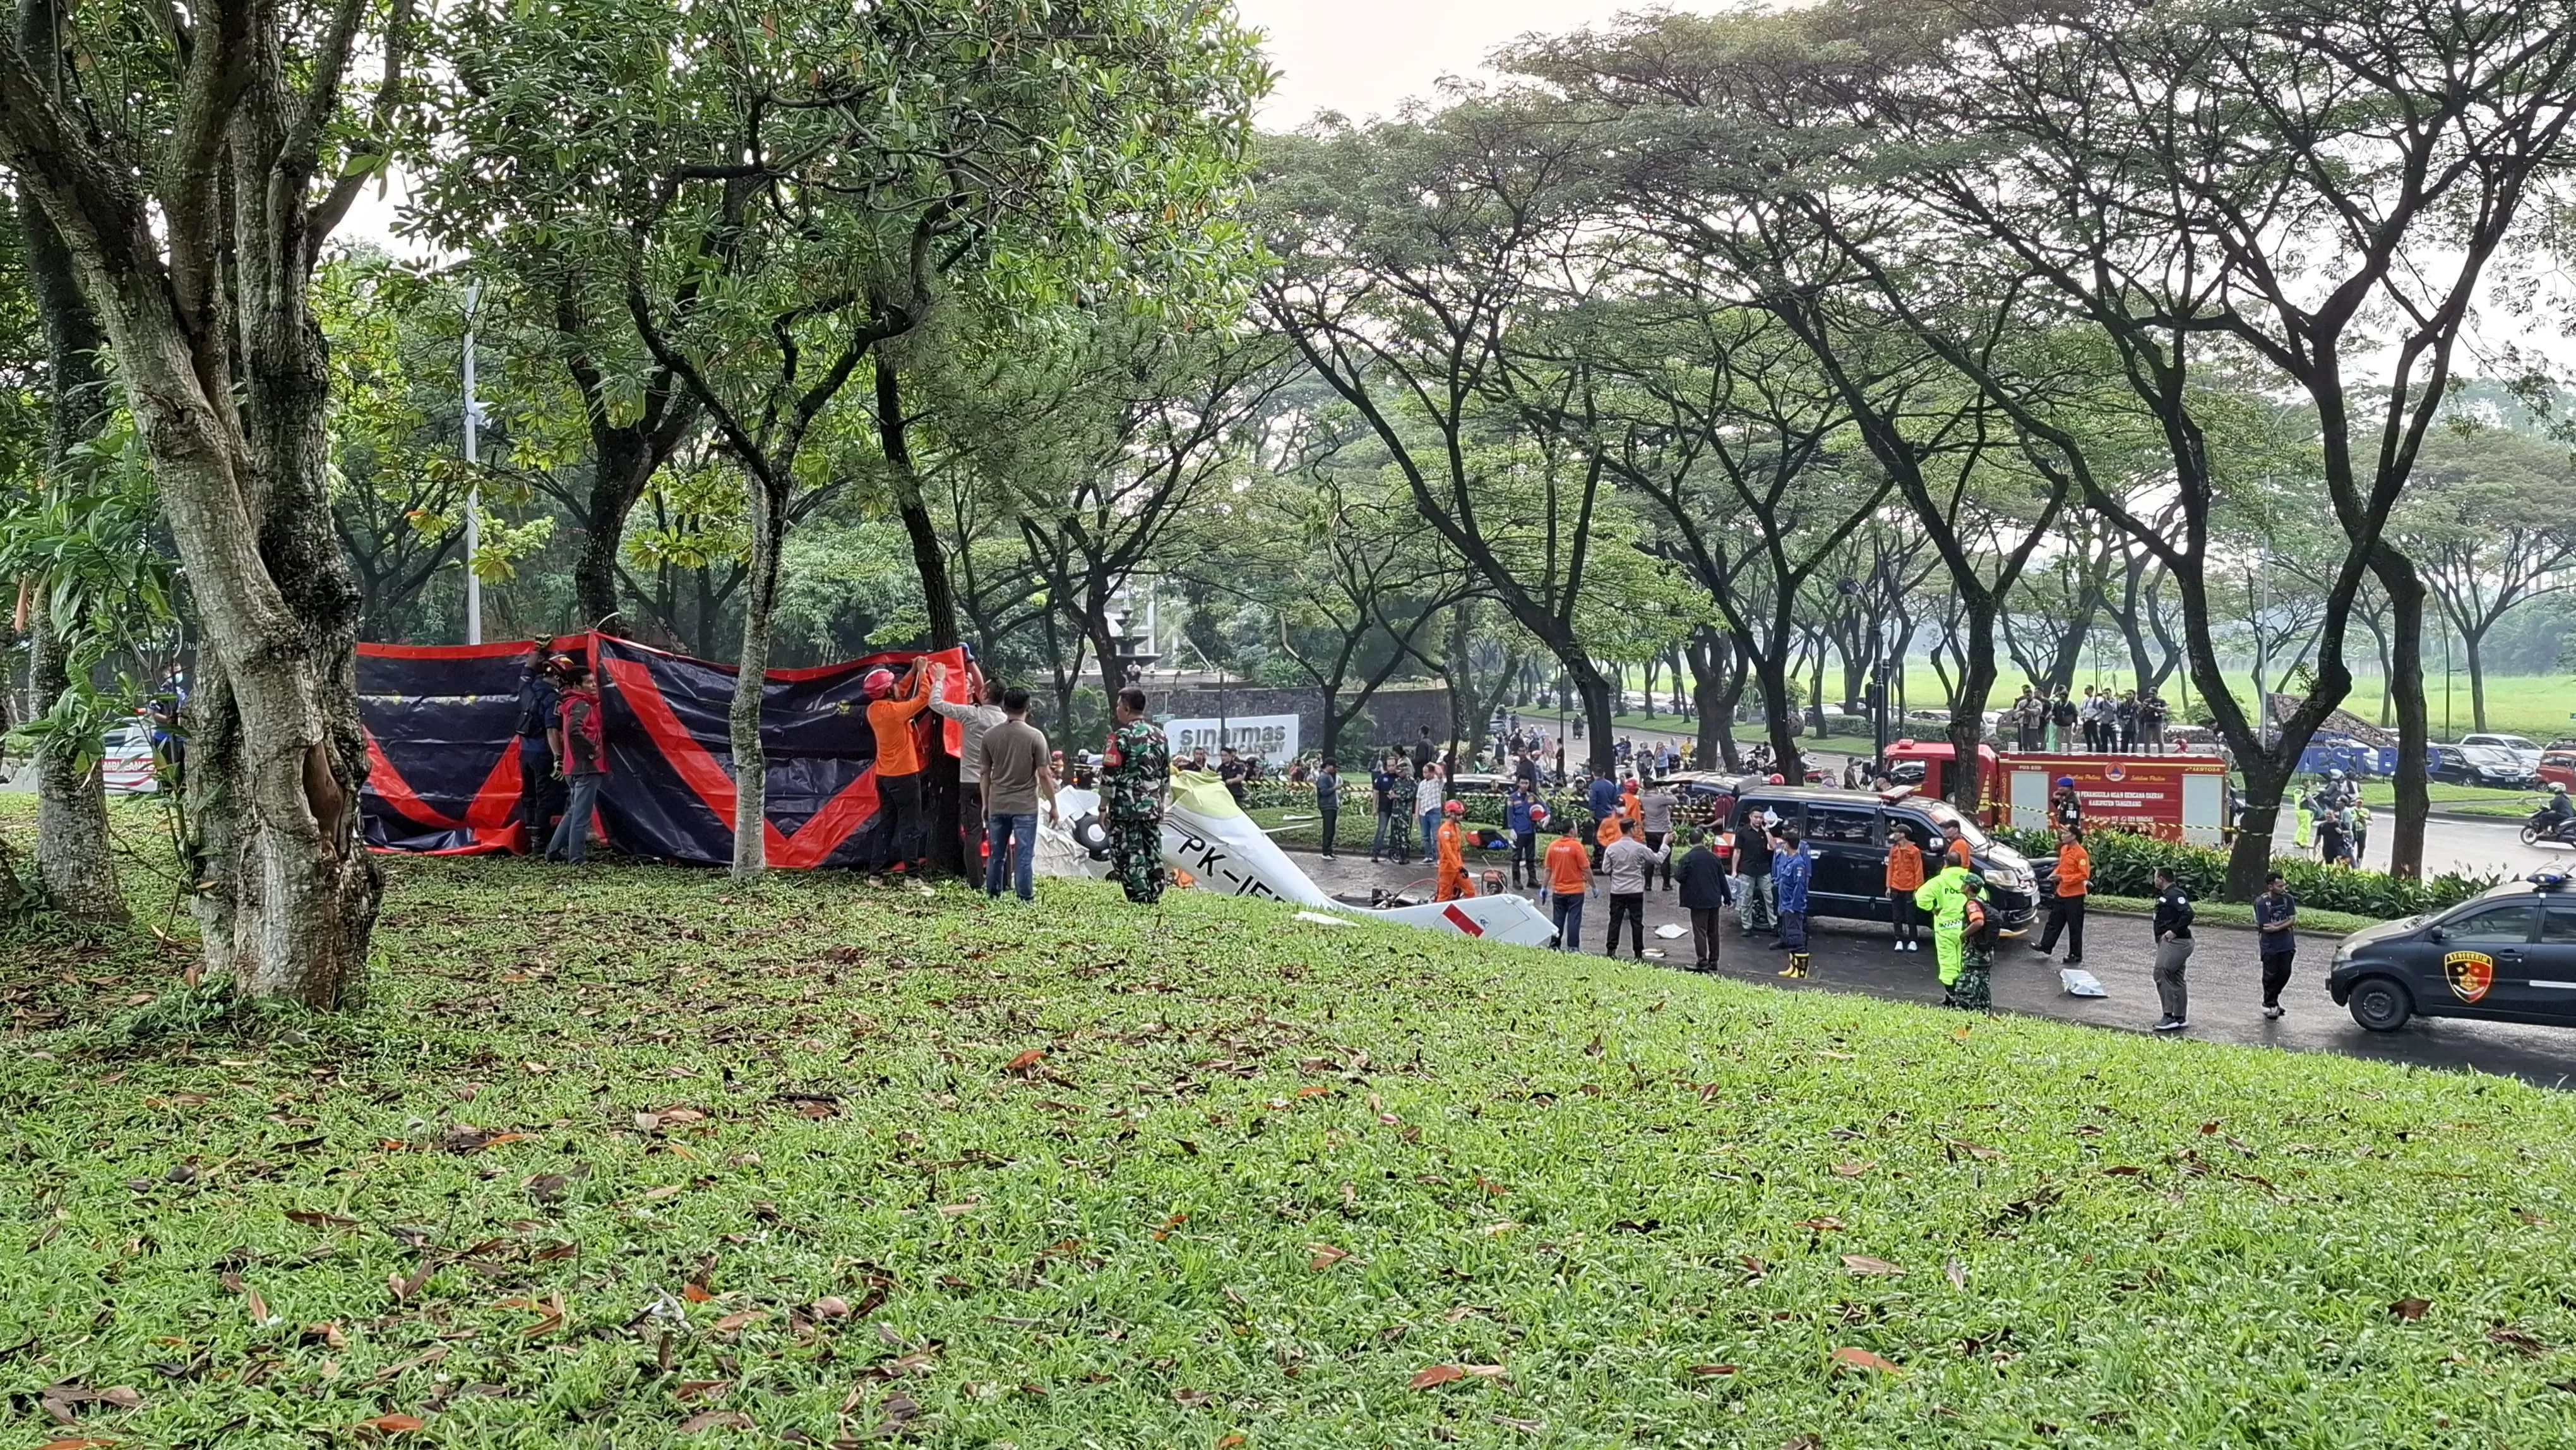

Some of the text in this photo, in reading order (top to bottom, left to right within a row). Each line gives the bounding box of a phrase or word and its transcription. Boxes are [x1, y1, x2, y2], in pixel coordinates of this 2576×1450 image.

[1179, 726, 1285, 745] sinarmas
[1231, 741, 1285, 754] CADEMY
[2378, 746, 2440, 774] BD
[1178, 835, 1286, 902] PK-IF
